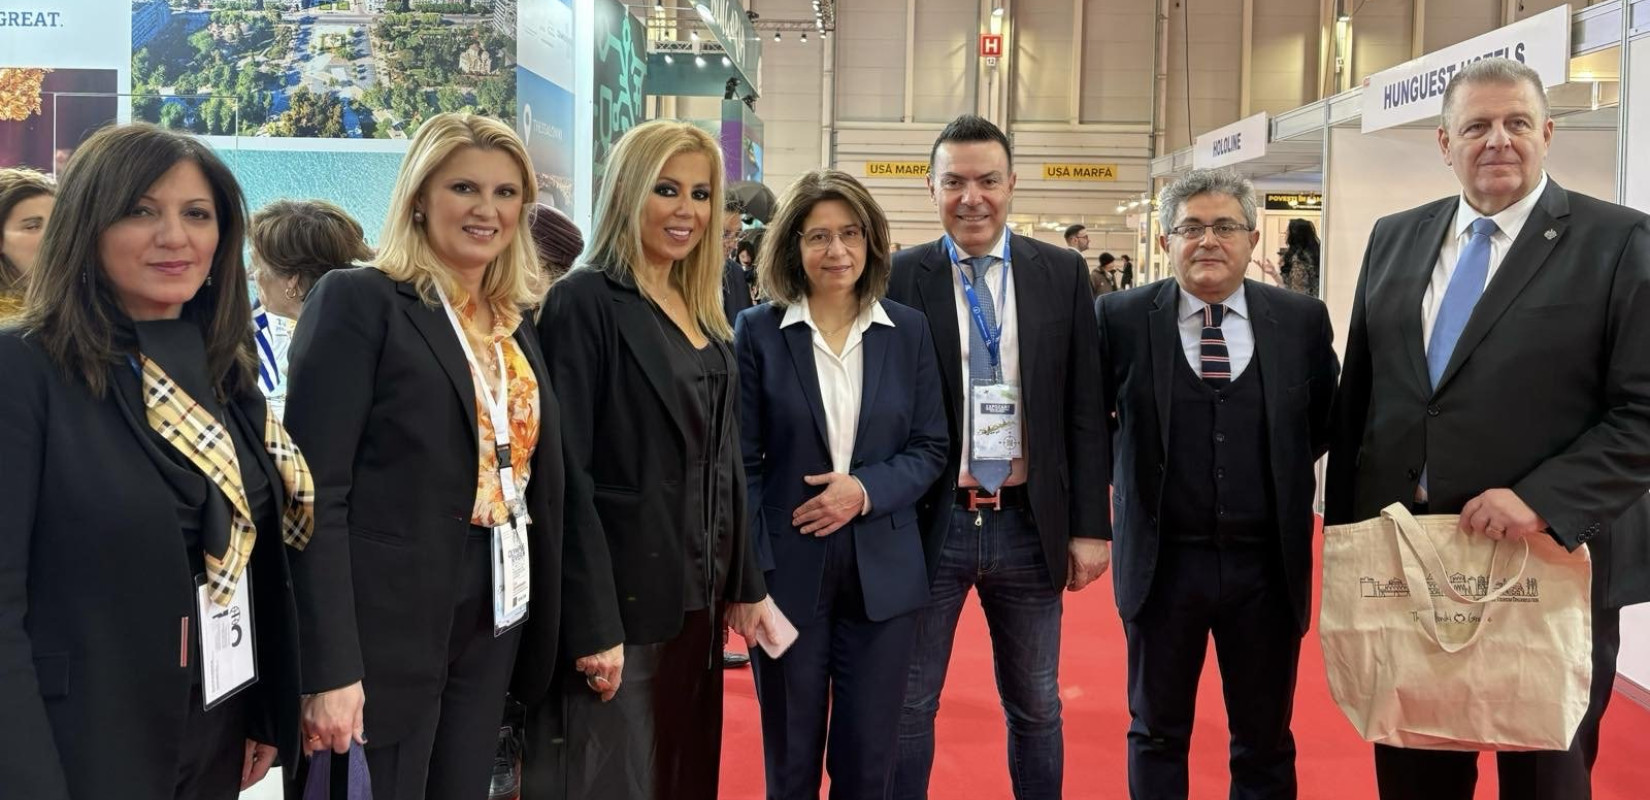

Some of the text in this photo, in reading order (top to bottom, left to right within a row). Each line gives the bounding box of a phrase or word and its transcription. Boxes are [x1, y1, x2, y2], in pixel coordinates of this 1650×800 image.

[985, 38, 998, 53] H
[1384, 64, 1457, 110] HUNGUEST
[1212, 132, 1242, 157] HOLOLINE
